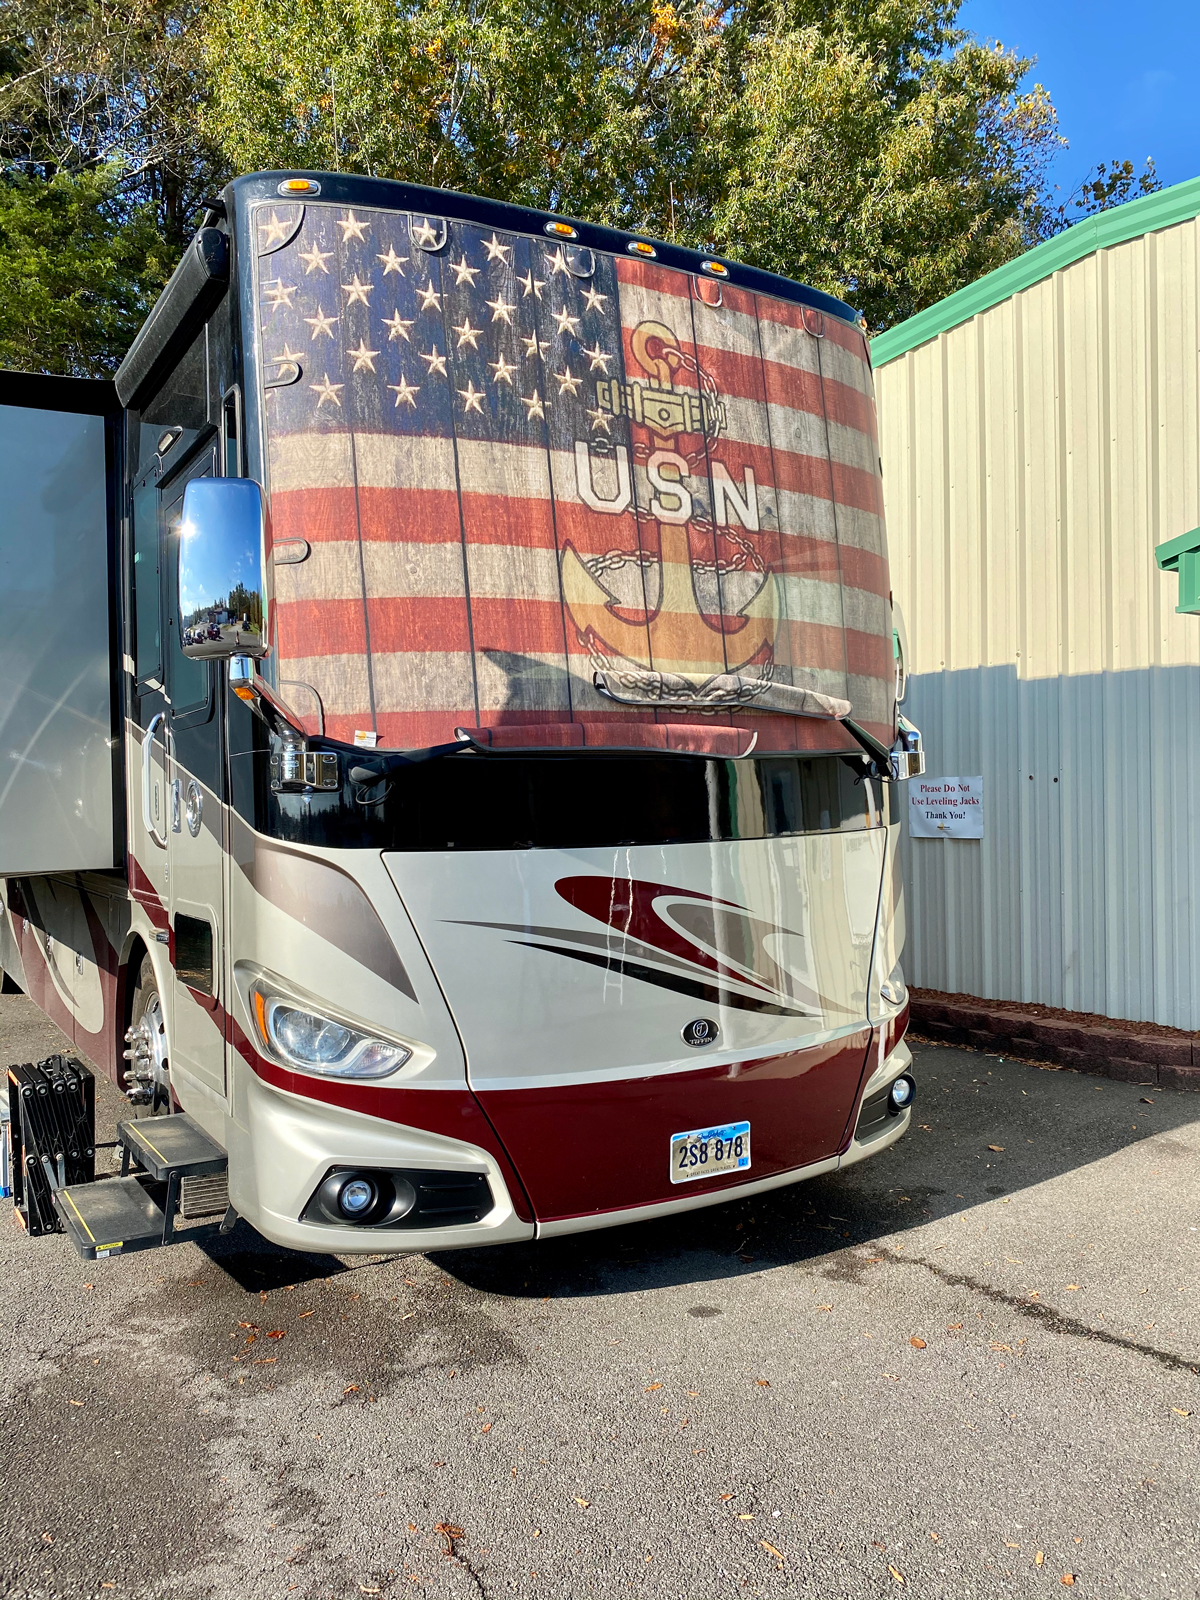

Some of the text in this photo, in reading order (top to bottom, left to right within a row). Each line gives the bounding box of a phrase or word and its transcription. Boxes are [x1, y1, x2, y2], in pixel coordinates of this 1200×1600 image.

[920, 784, 970, 792] Please Do Not
[911, 797, 979, 807] Use Leveling Jacks
[925, 811, 966, 819] Thank You!
[679, 1136, 743, 1168] 2S8 878
